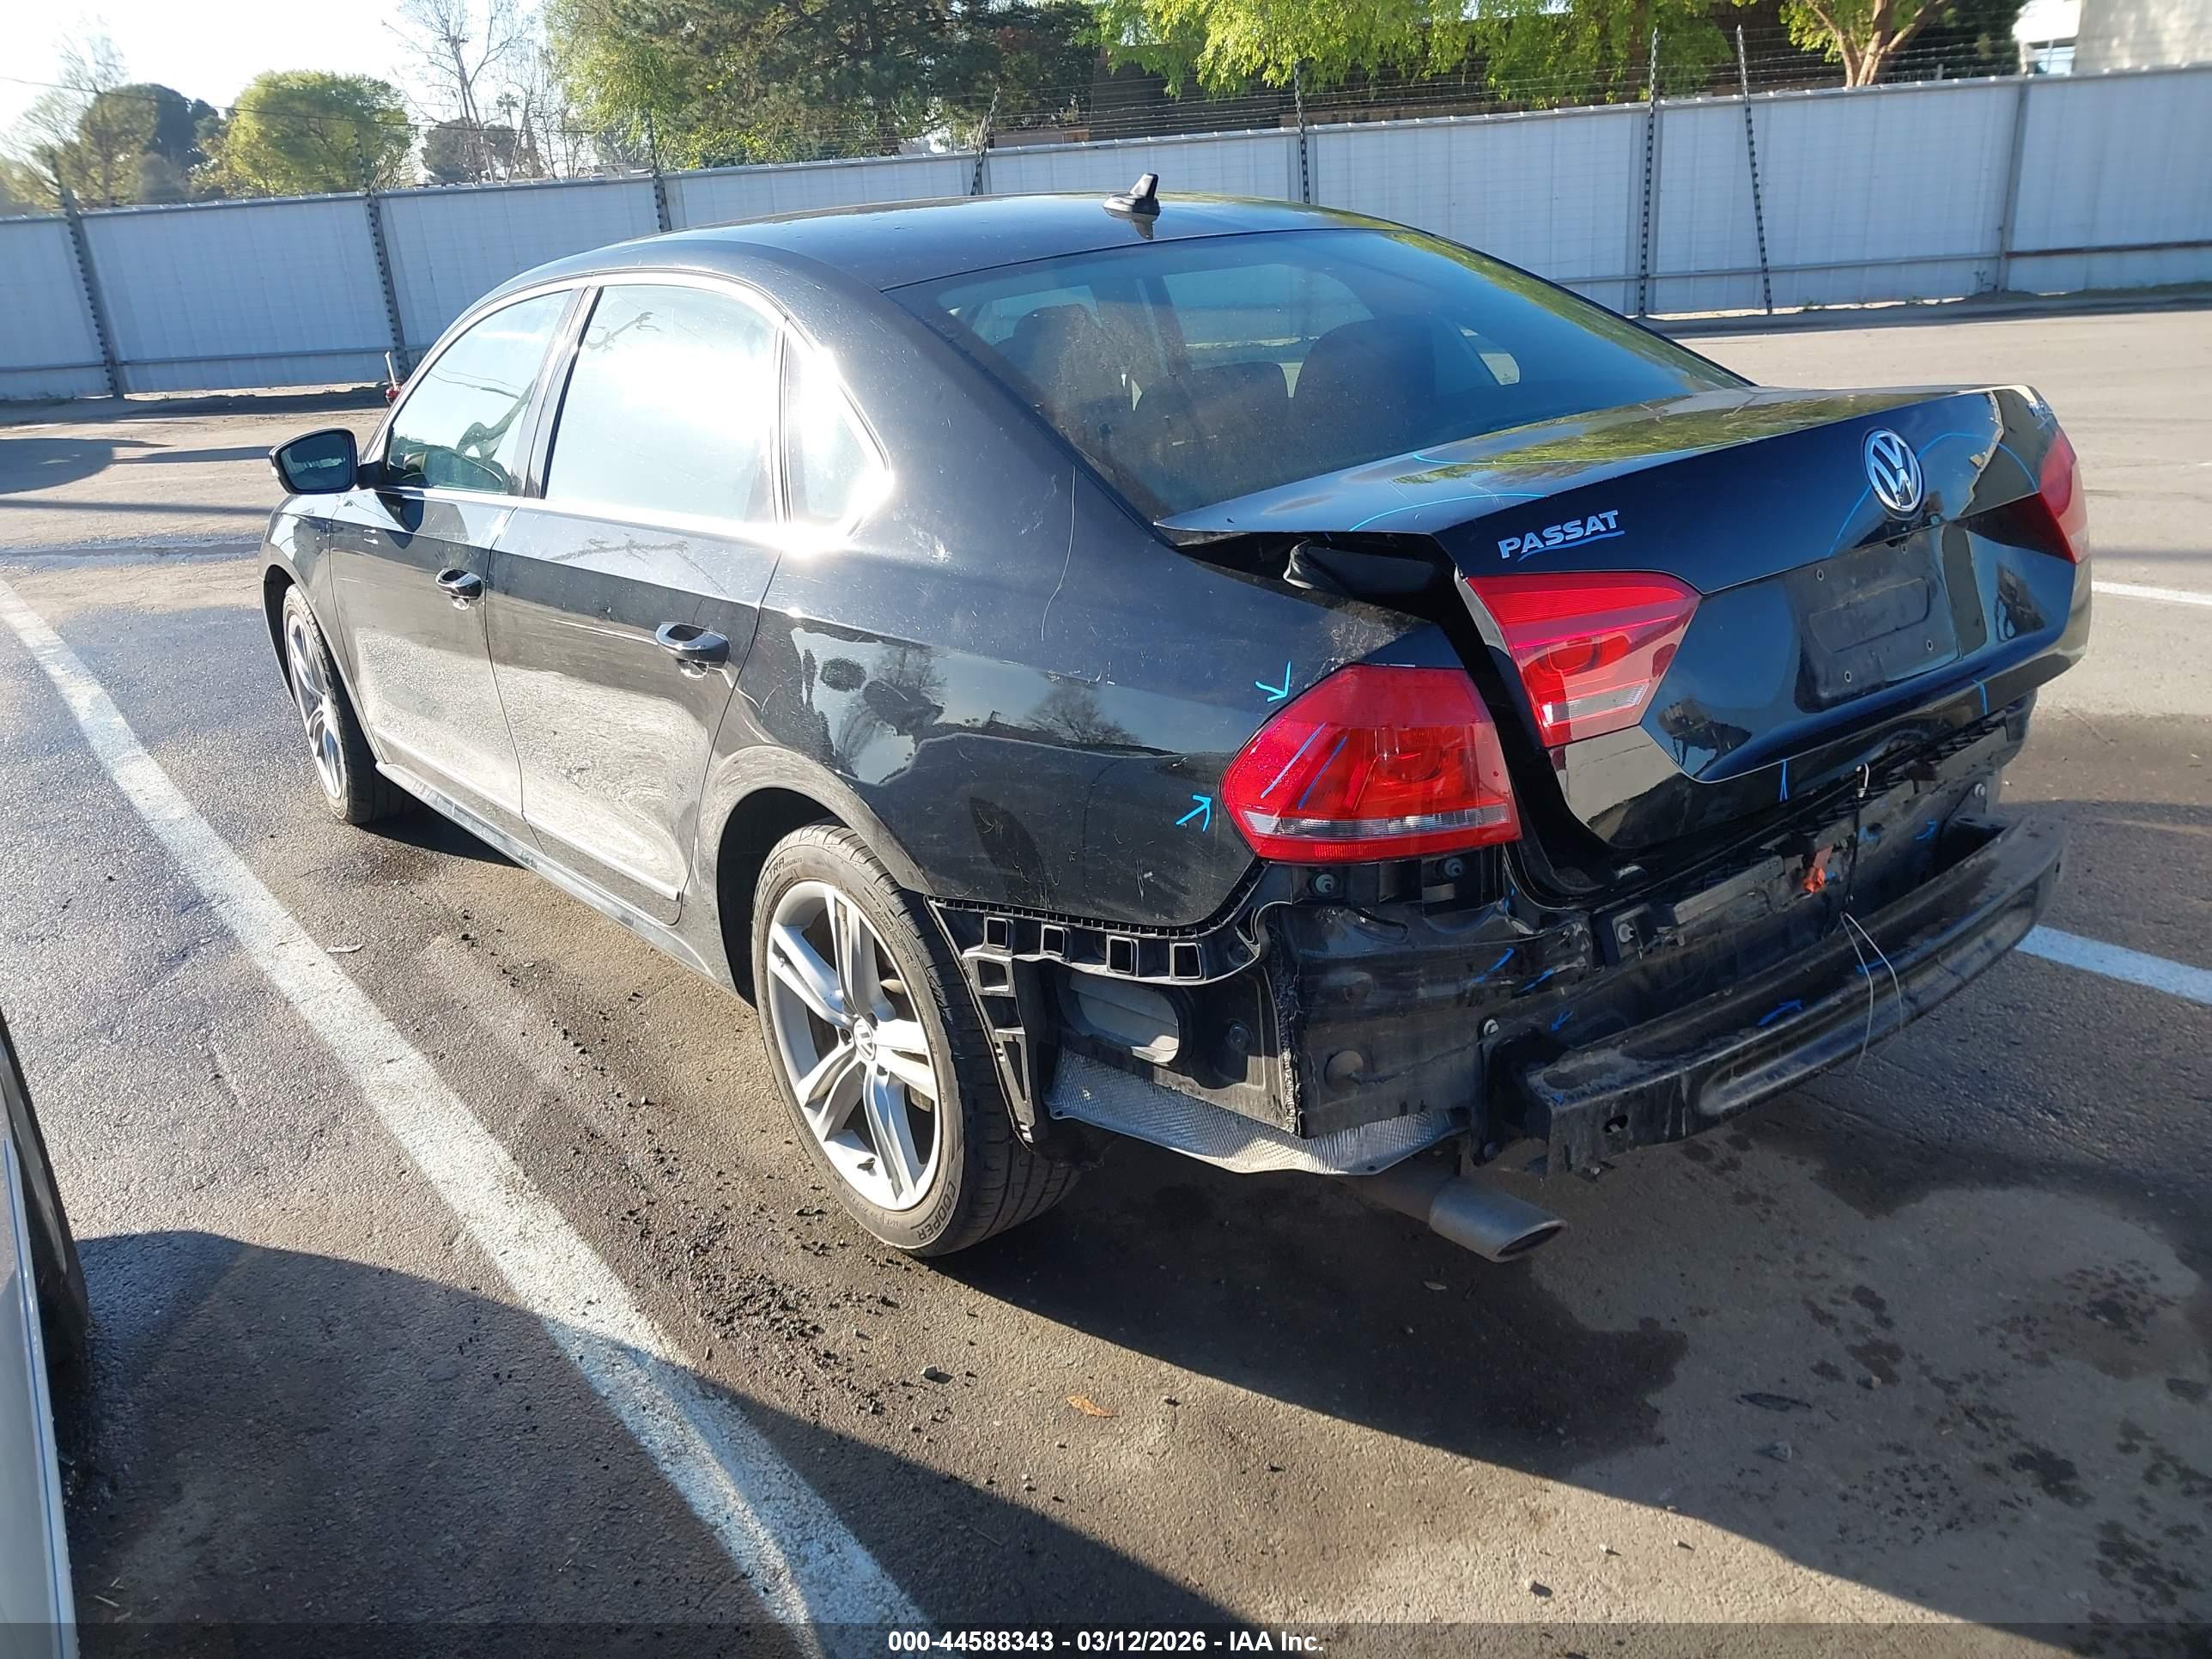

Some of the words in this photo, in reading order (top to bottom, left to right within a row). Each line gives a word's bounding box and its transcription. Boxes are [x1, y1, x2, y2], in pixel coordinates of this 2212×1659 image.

[1498, 510, 1619, 559] PASSAT
[761, 857, 785, 896] ULTRA
[917, 1180, 957, 1241] COOPER
